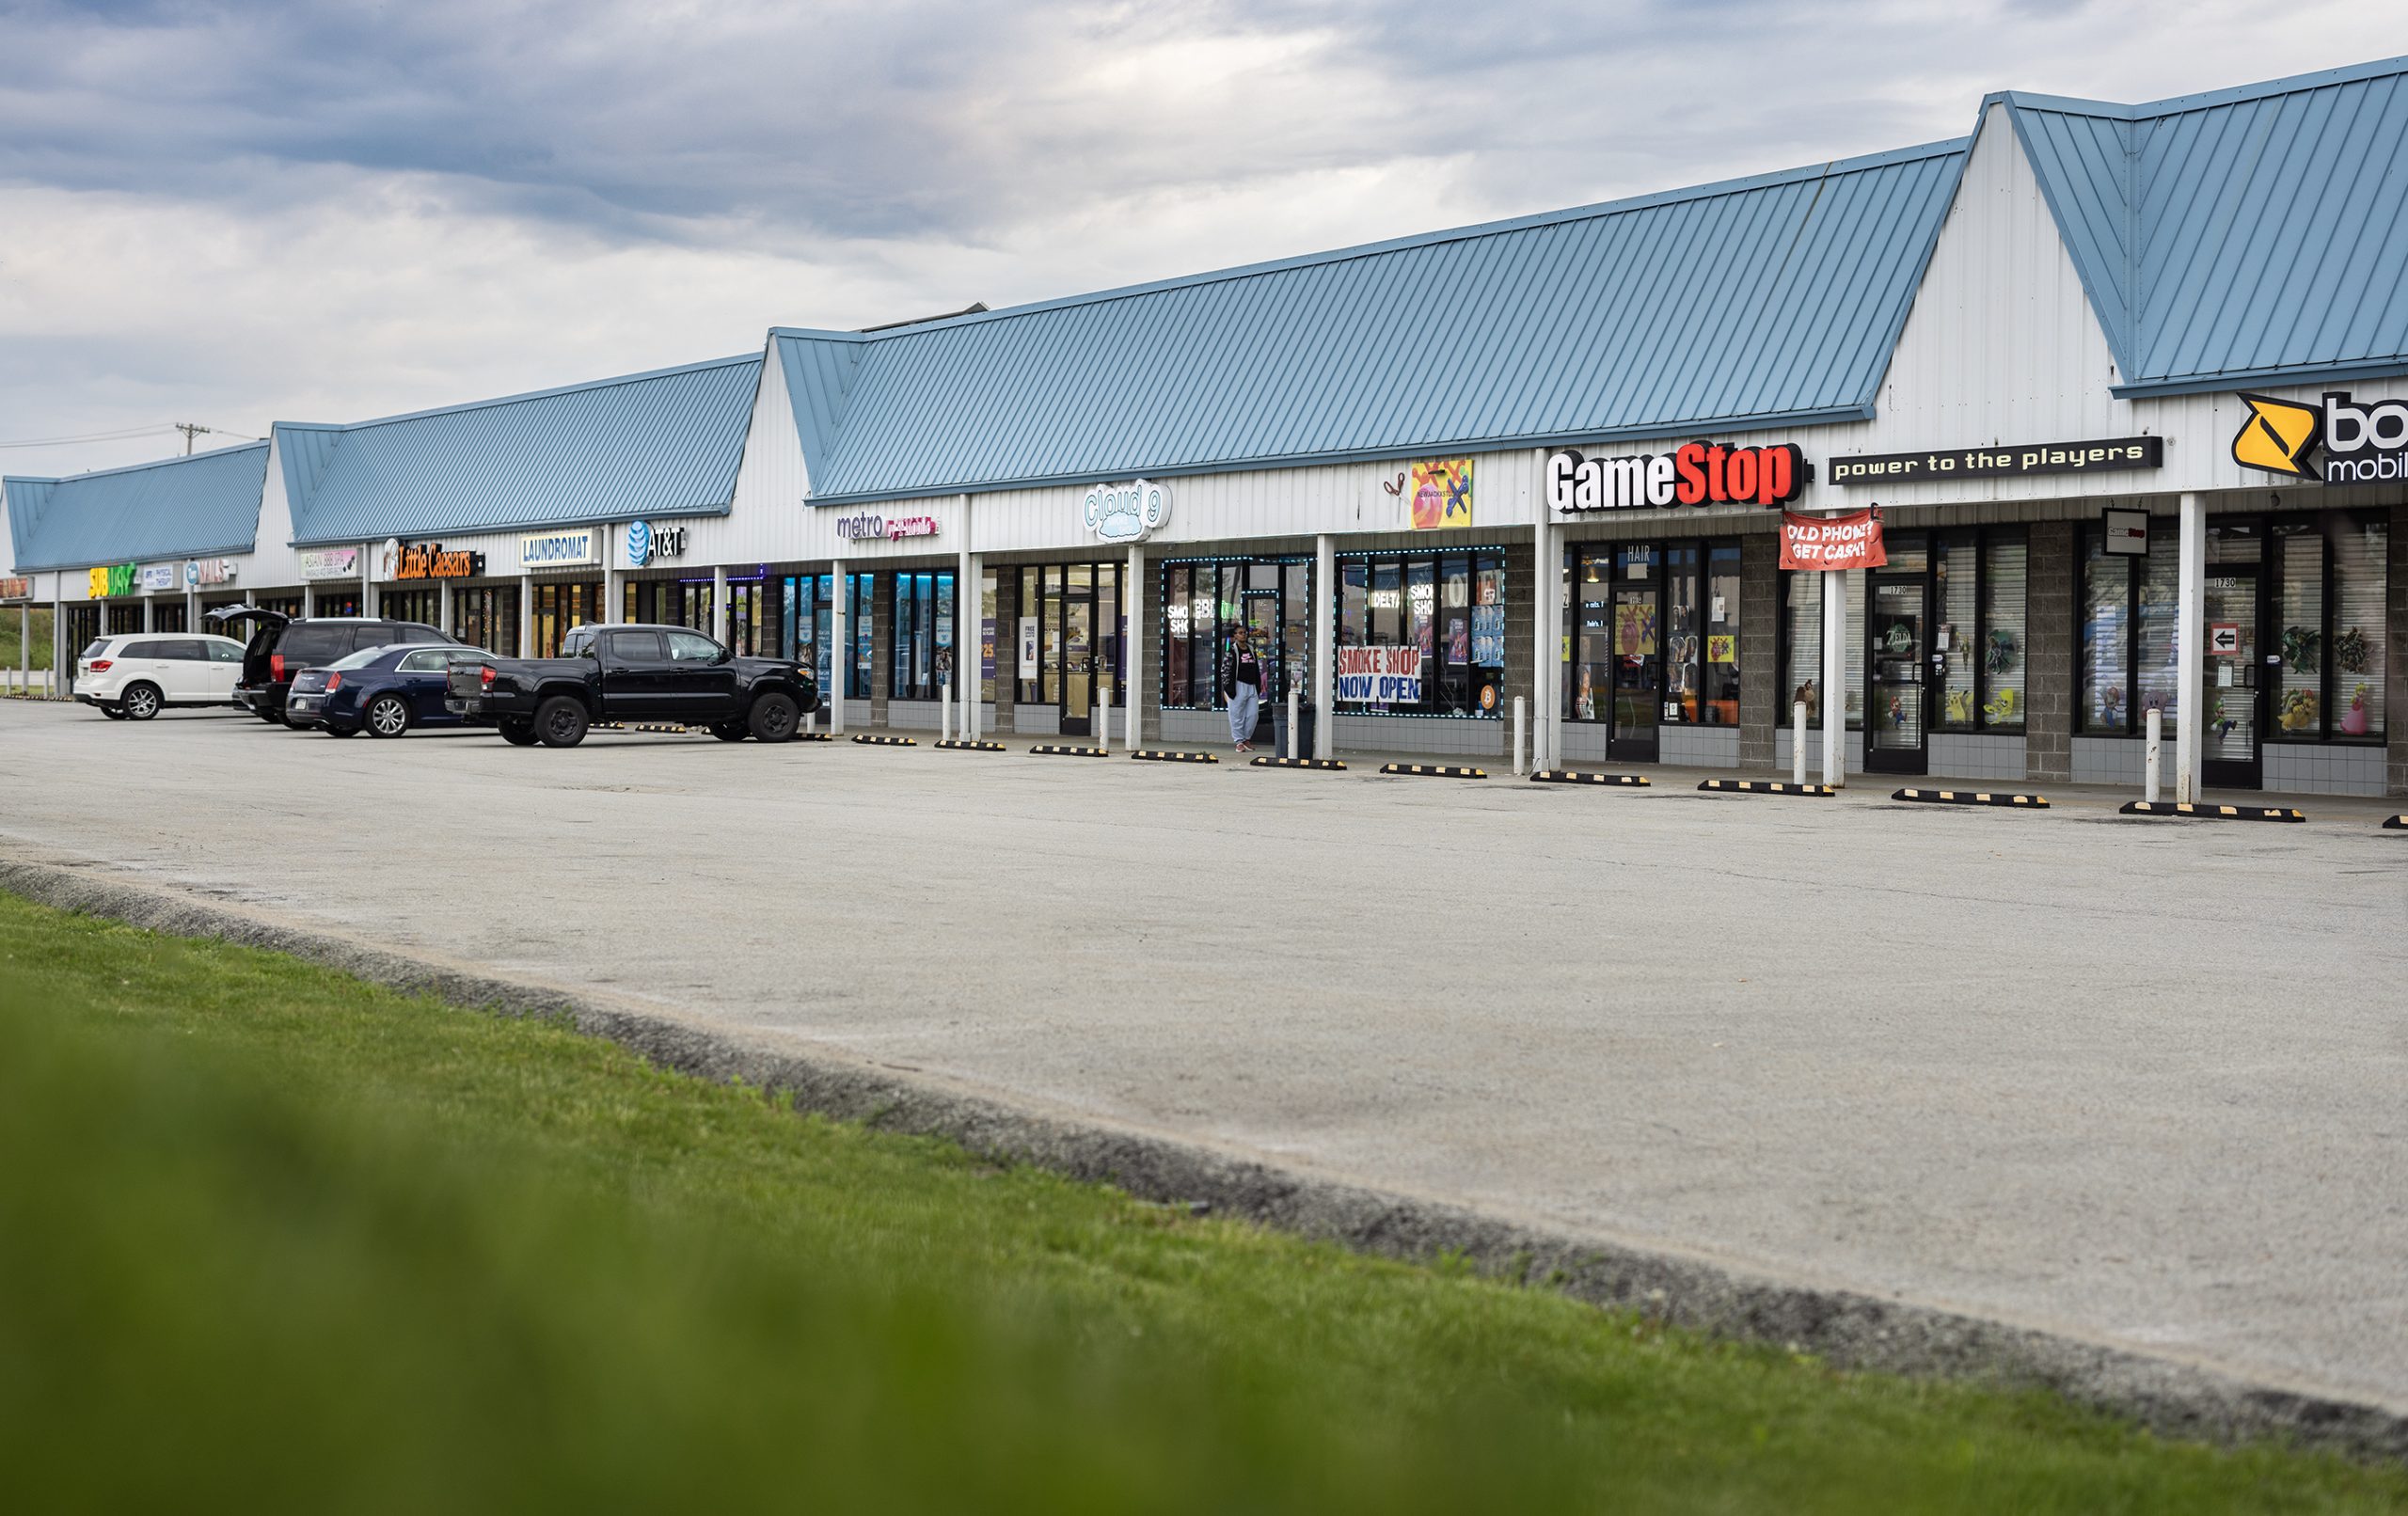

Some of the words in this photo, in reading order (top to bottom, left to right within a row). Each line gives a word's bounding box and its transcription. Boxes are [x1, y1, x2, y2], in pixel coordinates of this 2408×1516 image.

[2327, 398, 2408, 451] bo
[1834, 460, 1918, 481] power
[1927, 455, 1955, 471] to
[1965, 452, 2011, 469] the
[2022, 444, 2143, 470] players
[1546, 443, 1792, 511] GameStop
[1085, 484, 1142, 527] Cloud
[1148, 490, 1161, 522] 9
[837, 512, 882, 538] metro
[1787, 525, 1819, 541] OLD
[1822, 520, 1874, 541] PHONE?
[2108, 527, 2146, 539] GameStop
[523, 535, 588, 561] LAUNDROMAT
[647, 528, 680, 557] AT&T
[1627, 545, 1650, 562] HAIR
[1792, 544, 1823, 560] GET
[1824, 541, 1865, 560] CASH!
[199, 559, 224, 583] NAILS
[305, 554, 322, 567] ASIAN
[398, 545, 427, 579] Little
[429, 543, 470, 577] Caesars
[88, 562, 136, 599] SUBWAY
[2215, 578, 2236, 588] 1730
[1886, 630, 1911, 646] ZELDA
[1339, 648, 1381, 674] SMOKE
[1386, 648, 1419, 675] SHOP
[1339, 675, 1373, 699] NOW
[1379, 675, 1420, 700] OPEN
